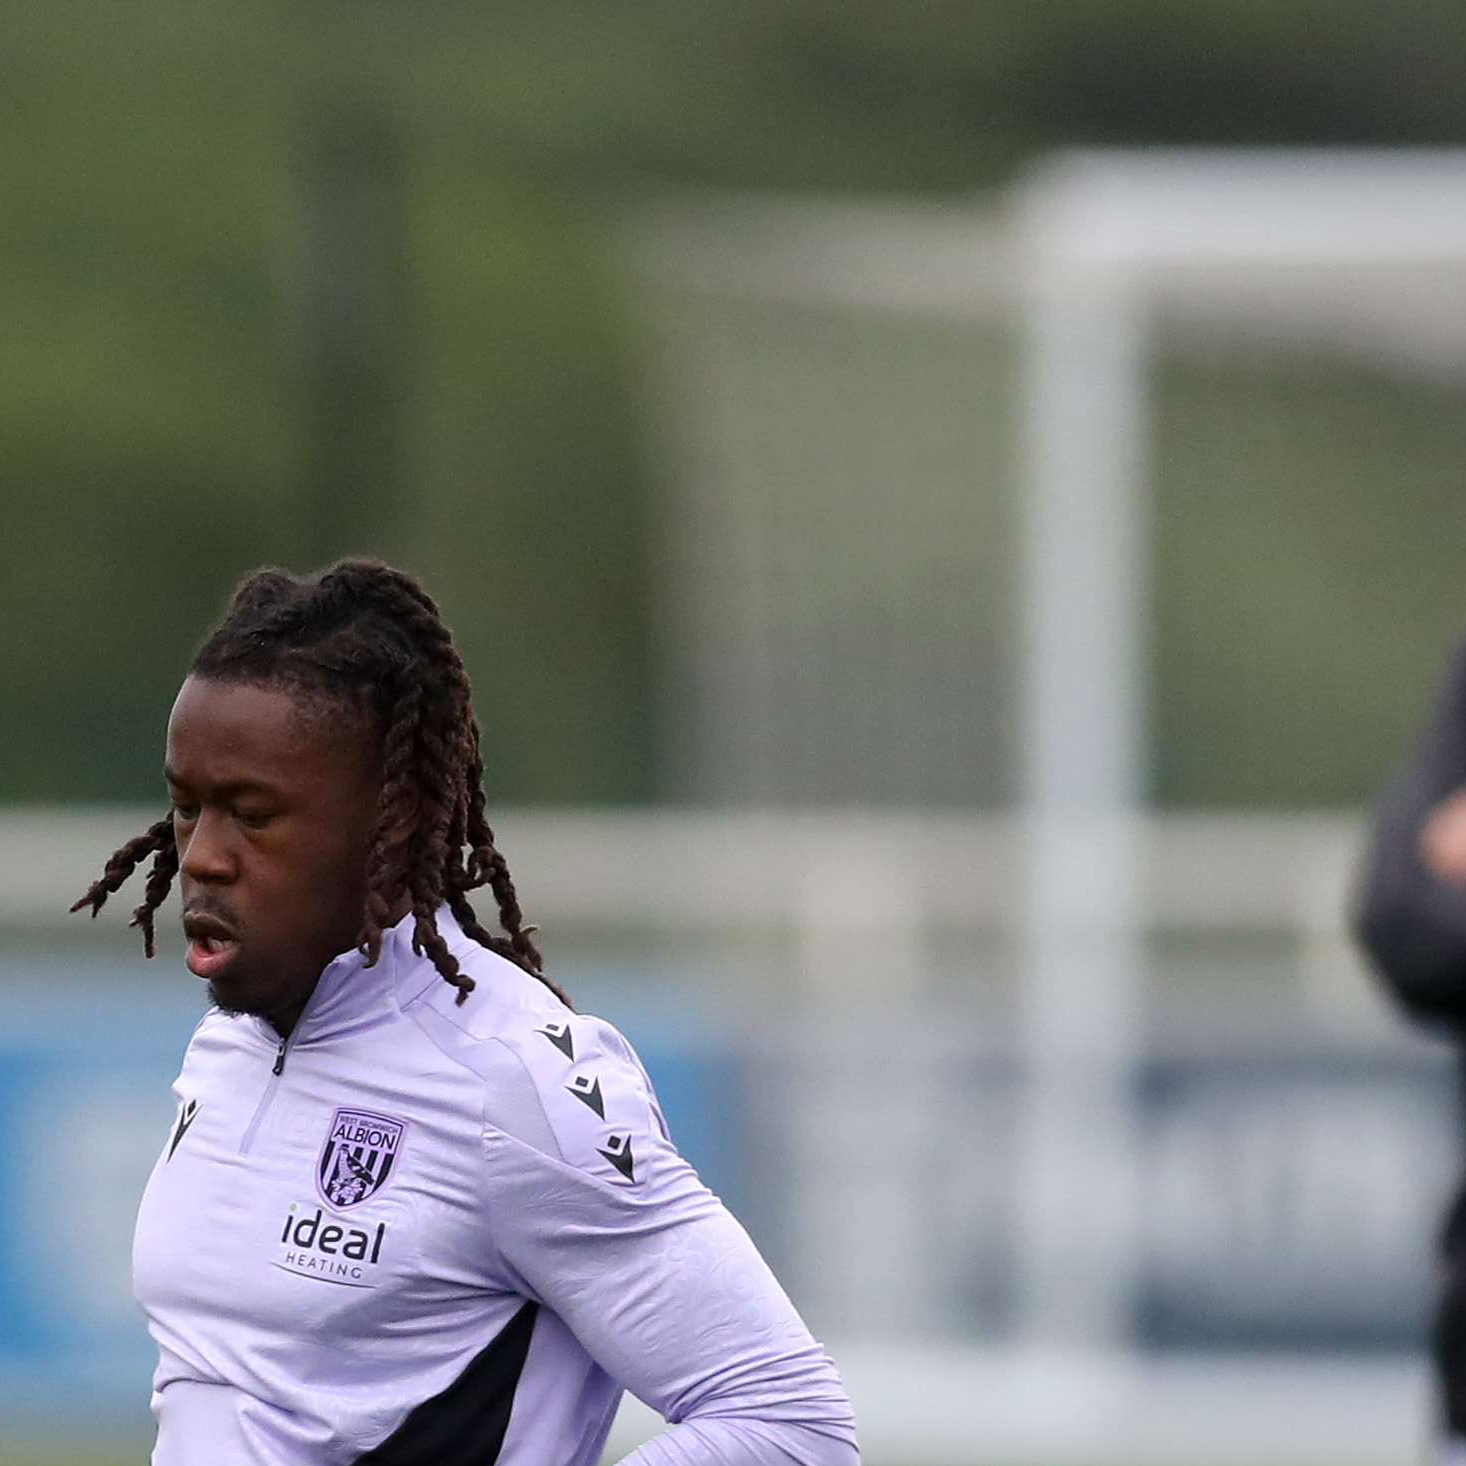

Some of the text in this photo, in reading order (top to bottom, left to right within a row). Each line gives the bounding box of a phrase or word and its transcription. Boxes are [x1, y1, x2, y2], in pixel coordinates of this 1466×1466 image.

[334, 1124, 396, 1149] ALBION
[281, 1202, 385, 1264] ideal
[286, 1252, 362, 1279] HEATING
